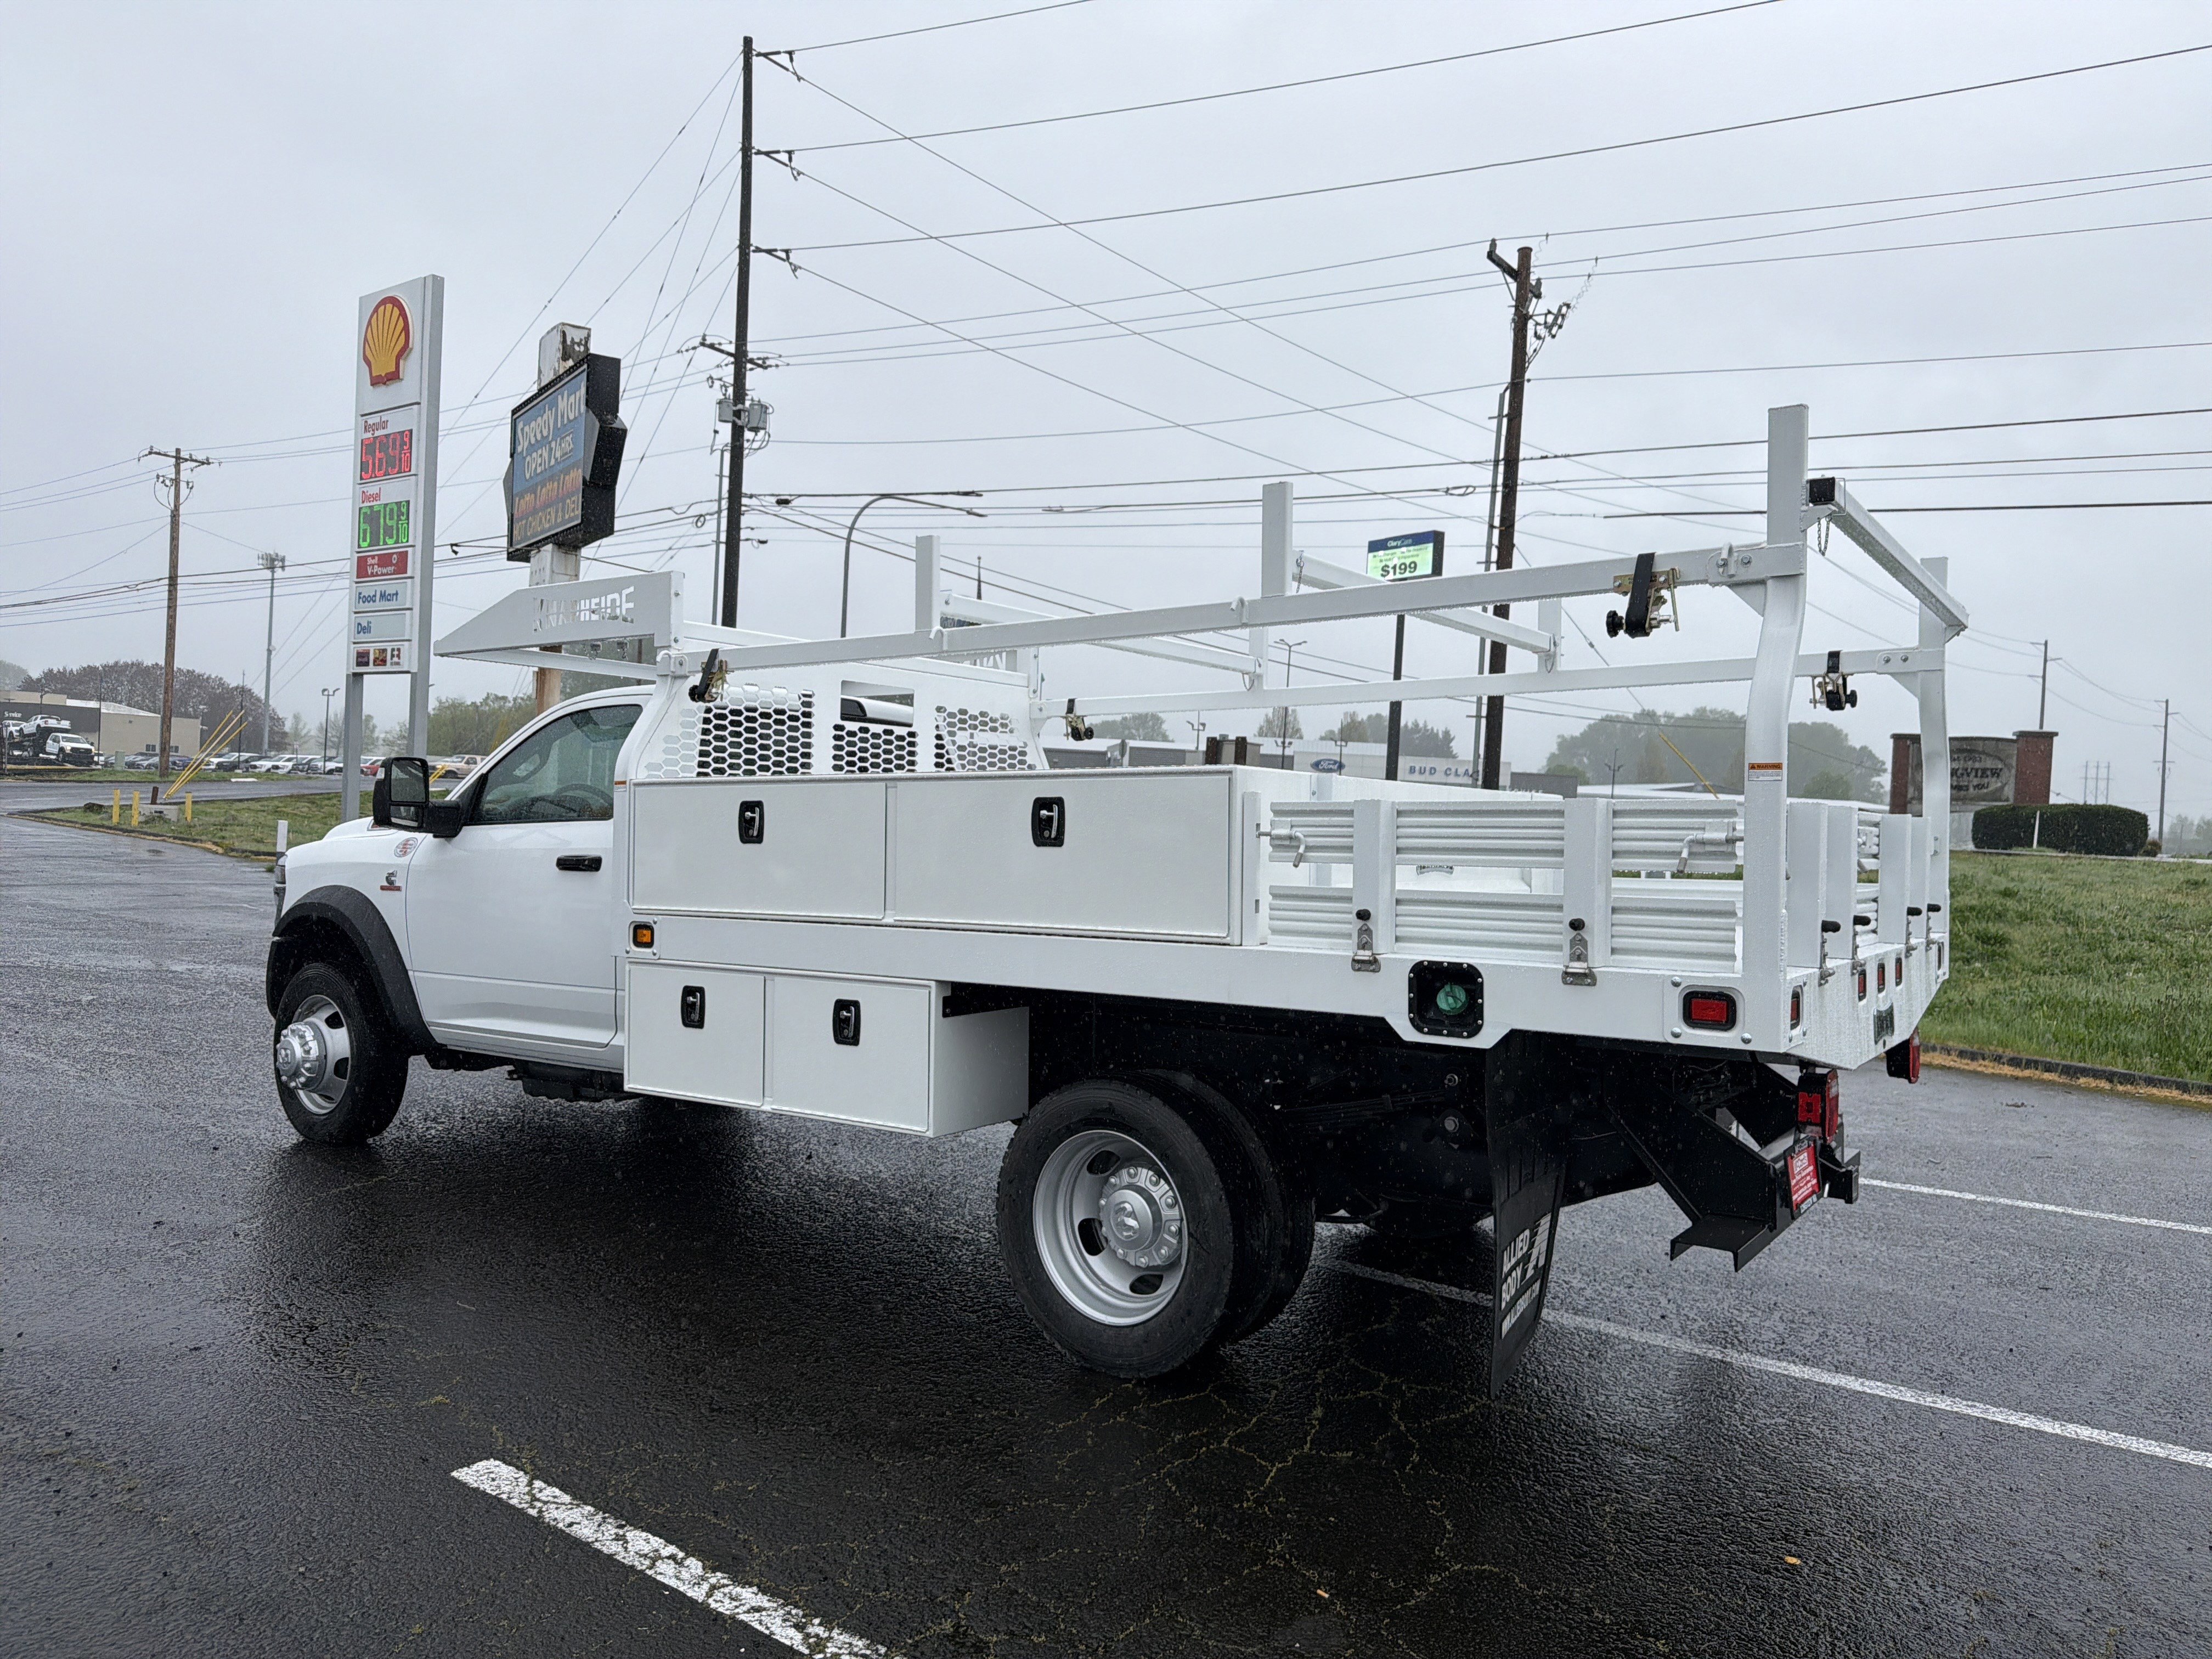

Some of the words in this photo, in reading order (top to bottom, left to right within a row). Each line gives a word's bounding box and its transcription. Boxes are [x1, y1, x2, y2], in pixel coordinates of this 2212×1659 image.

[364, 416, 389, 436] Regular
[517, 404, 555, 457] Speedy
[557, 381, 585, 428] Mart
[362, 432, 400, 479] 5.69
[525, 445, 548, 479] OPEN
[362, 487, 381, 504] Diesel
[513, 520, 526, 541] HOT
[527, 505, 555, 536] CHICKEN
[565, 493, 582, 519] DELI
[367, 556, 378, 565] Shell
[367, 565, 394, 575] V-Power
[1380, 561, 1418, 577] $199
[358, 590, 377, 603] Food
[379, 590, 399, 602] Mart
[357, 620, 372, 635] Deli
[1318, 760, 1339, 769] Ford
[1408, 765, 1437, 775] BUD
[1444, 767, 1475, 777] CLA
[1950, 767, 2004, 778] NGVIEW
[1502, 1229, 1530, 1279] ALLIED
[1501, 1262, 1523, 1311] BODY
